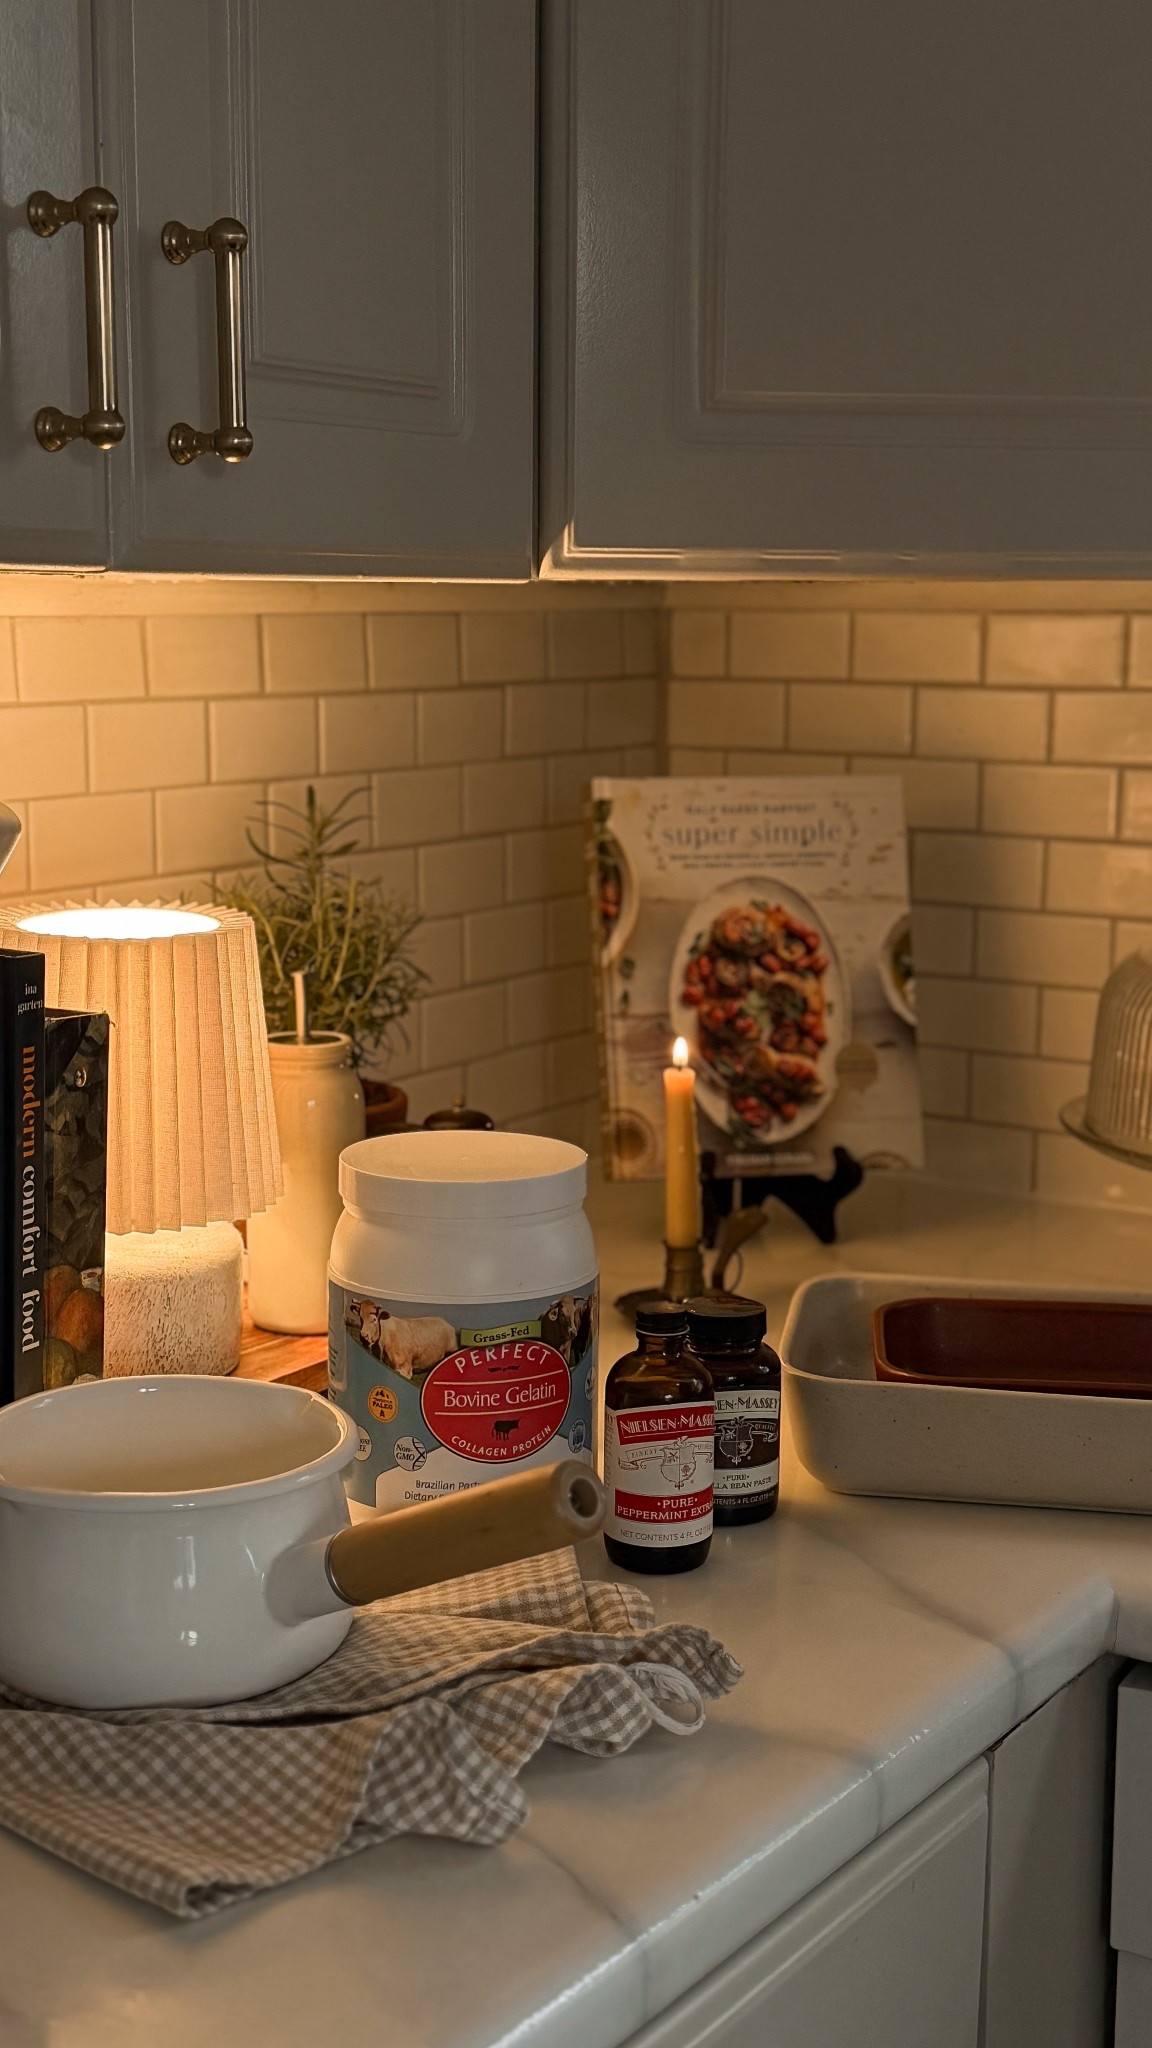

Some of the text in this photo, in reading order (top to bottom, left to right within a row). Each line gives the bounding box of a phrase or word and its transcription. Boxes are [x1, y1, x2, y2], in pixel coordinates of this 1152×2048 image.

[661, 818, 842, 850] super simple
[25, 983, 38, 996] ina
[17, 999, 43, 1016] garten
[22, 1045, 41, 1354] modern comfort food
[473, 1326, 530, 1344] Grass-Fed
[454, 1343, 551, 1374] PERFECT
[444, 1382, 556, 1408] Bovine Gelatin
[372, 1401, 394, 1410] PALEO
[451, 1435, 507, 1457] COLLAGEN
[512, 1425, 552, 1454] PROTEIN
[396, 1444, 413, 1454] Non-
[396, 1453, 415, 1462] GMO
[415, 1480, 481, 1490] Brazilian Past
[730, 1481, 752, 1490] BEAN
[753, 1476, 772, 1487] PASTE
[662, 1497, 695, 1509] PURE
[617, 1505, 689, 1520] PEPPERMINT
[620, 1529, 633, 1538] NET
[635, 1532, 679, 1542] CONTENTS
